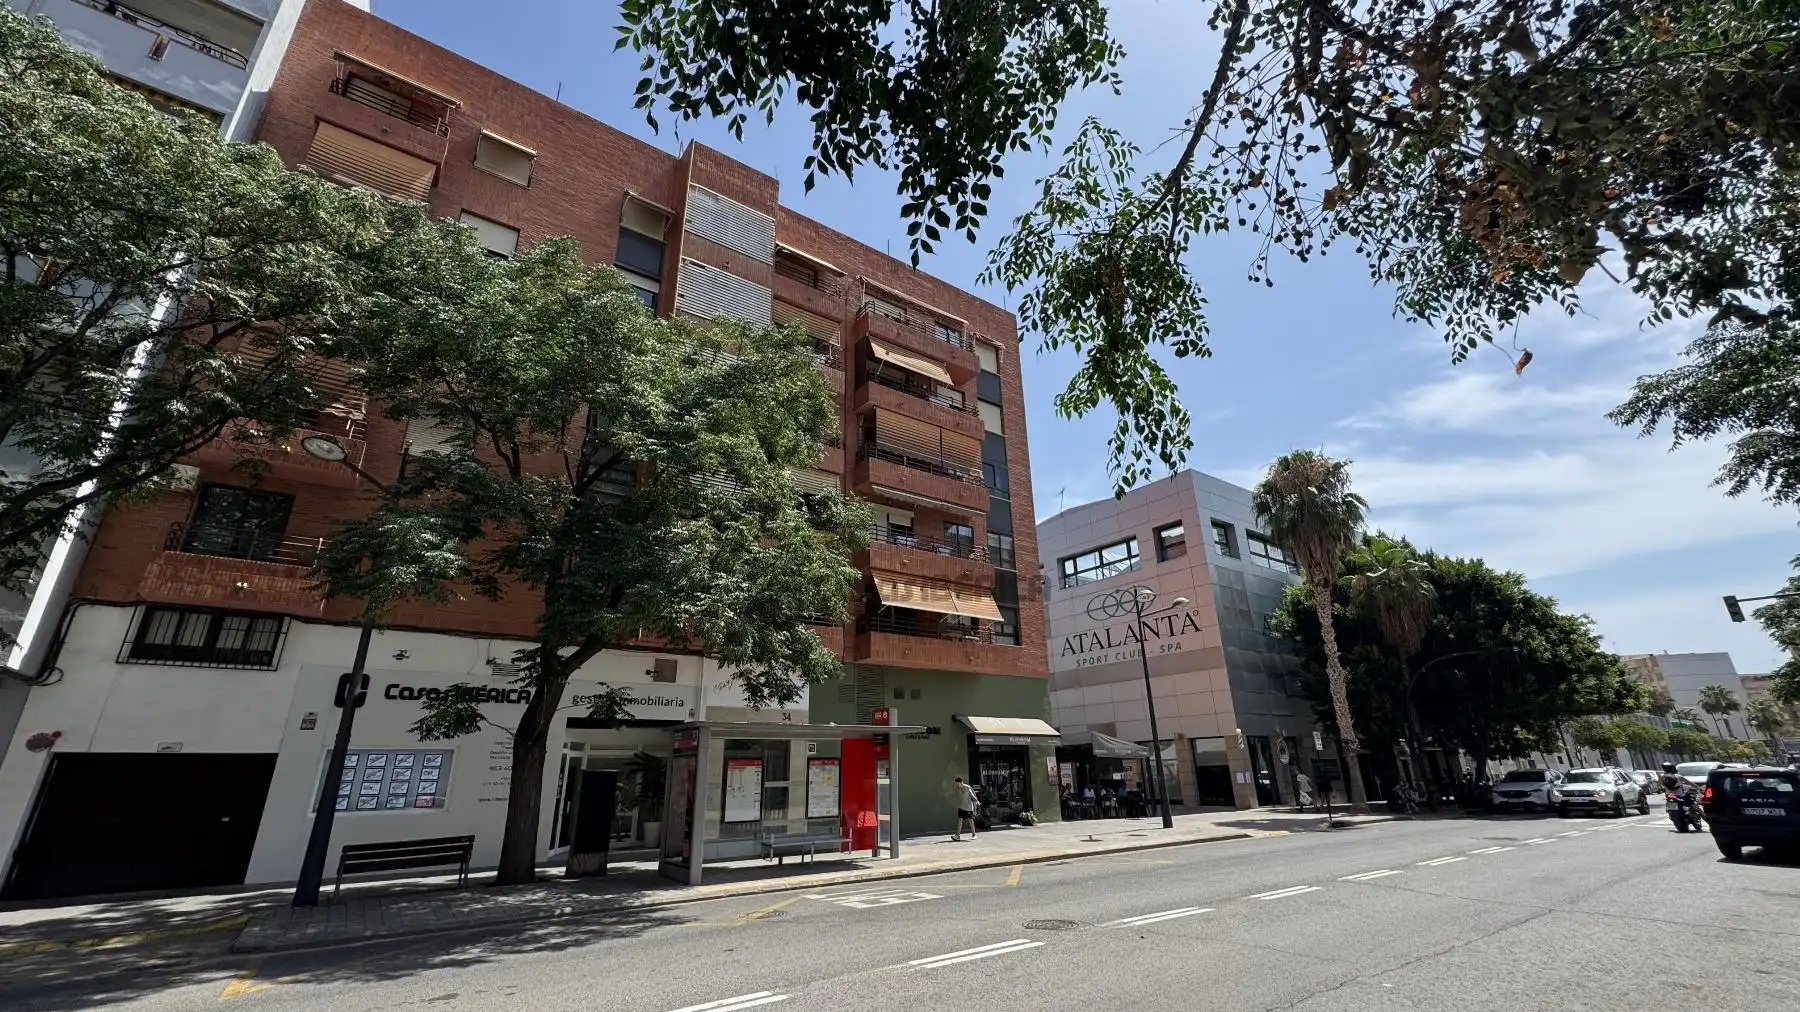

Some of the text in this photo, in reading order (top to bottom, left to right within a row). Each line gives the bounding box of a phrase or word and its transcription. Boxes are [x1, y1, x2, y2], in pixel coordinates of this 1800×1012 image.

[1061, 611, 1202, 657] ATALANTA
[1076, 655, 1109, 668] SPORT
[1159, 641, 1182, 653] SPA
[782, 712, 792, 721] 34
